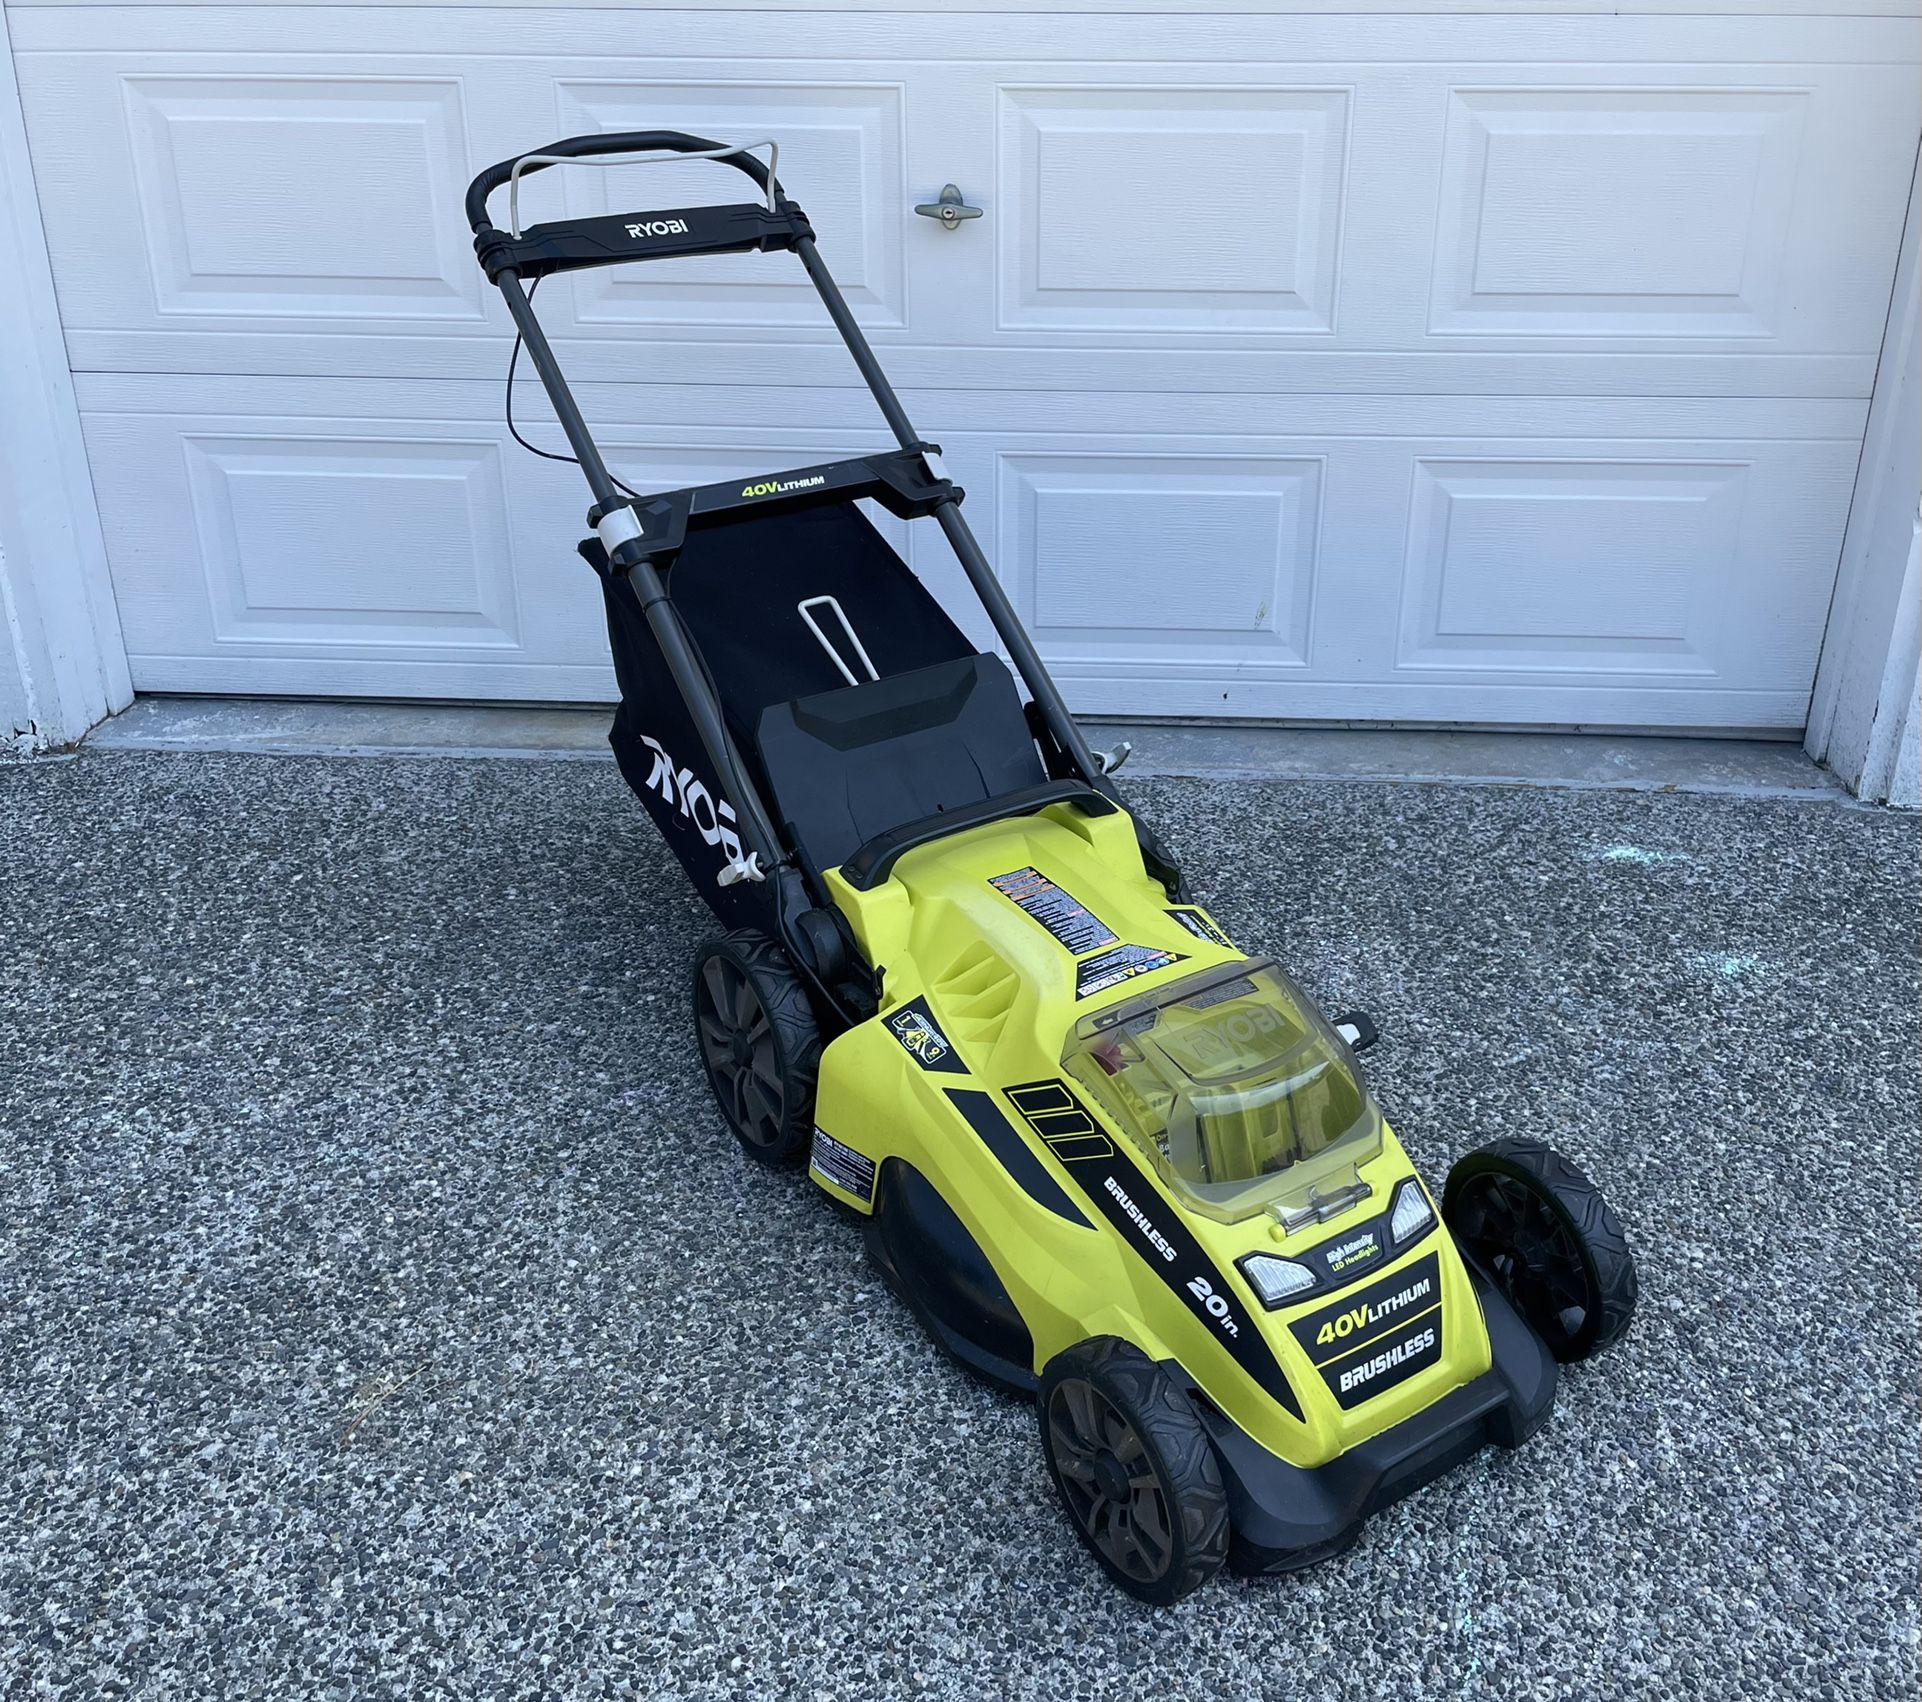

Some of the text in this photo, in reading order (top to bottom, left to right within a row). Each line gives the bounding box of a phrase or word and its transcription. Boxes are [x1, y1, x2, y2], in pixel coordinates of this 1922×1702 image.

[624, 219, 689, 238] RYOBI
[640, 735, 745, 866] RYOB
[1104, 1176, 1178, 1262] BRUSHLESS
[1331, 1244, 1379, 1272] LED Headlights
[1340, 1328, 1435, 1392] BRUSHLESS
